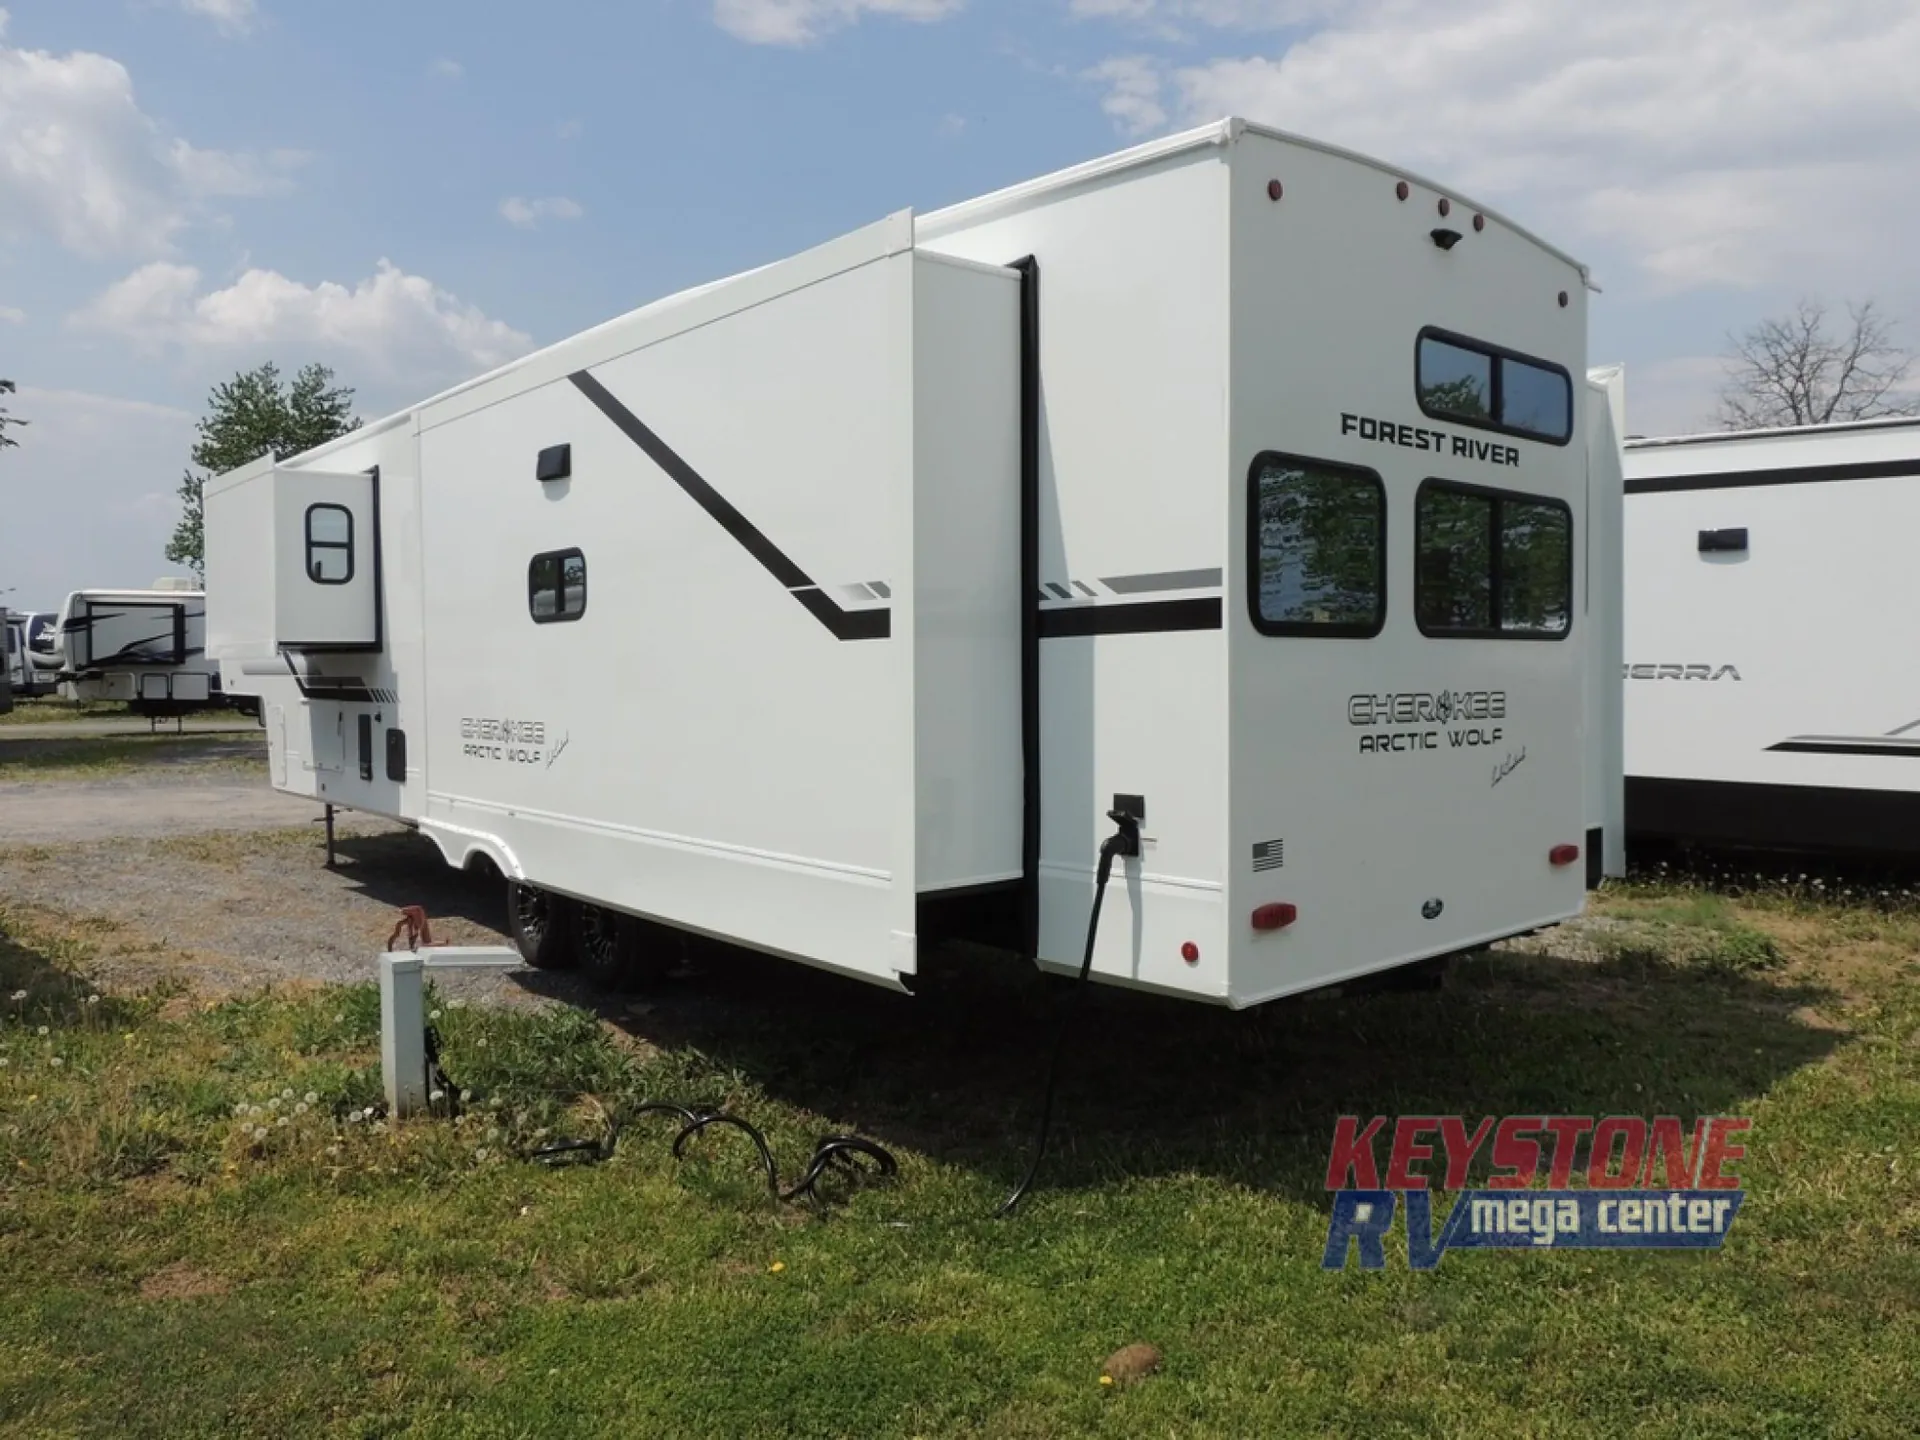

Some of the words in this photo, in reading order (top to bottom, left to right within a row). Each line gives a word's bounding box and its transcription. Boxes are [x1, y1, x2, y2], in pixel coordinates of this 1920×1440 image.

[1341, 412, 1446, 452] FOREST
[1452, 434, 1520, 467] RIVER
[1348, 690, 1506, 725] CHEROKEE
[1359, 732, 1438, 753] ARCTIC
[1448, 728, 1503, 748] WOLF
[507, 749, 541, 764] WOLF
